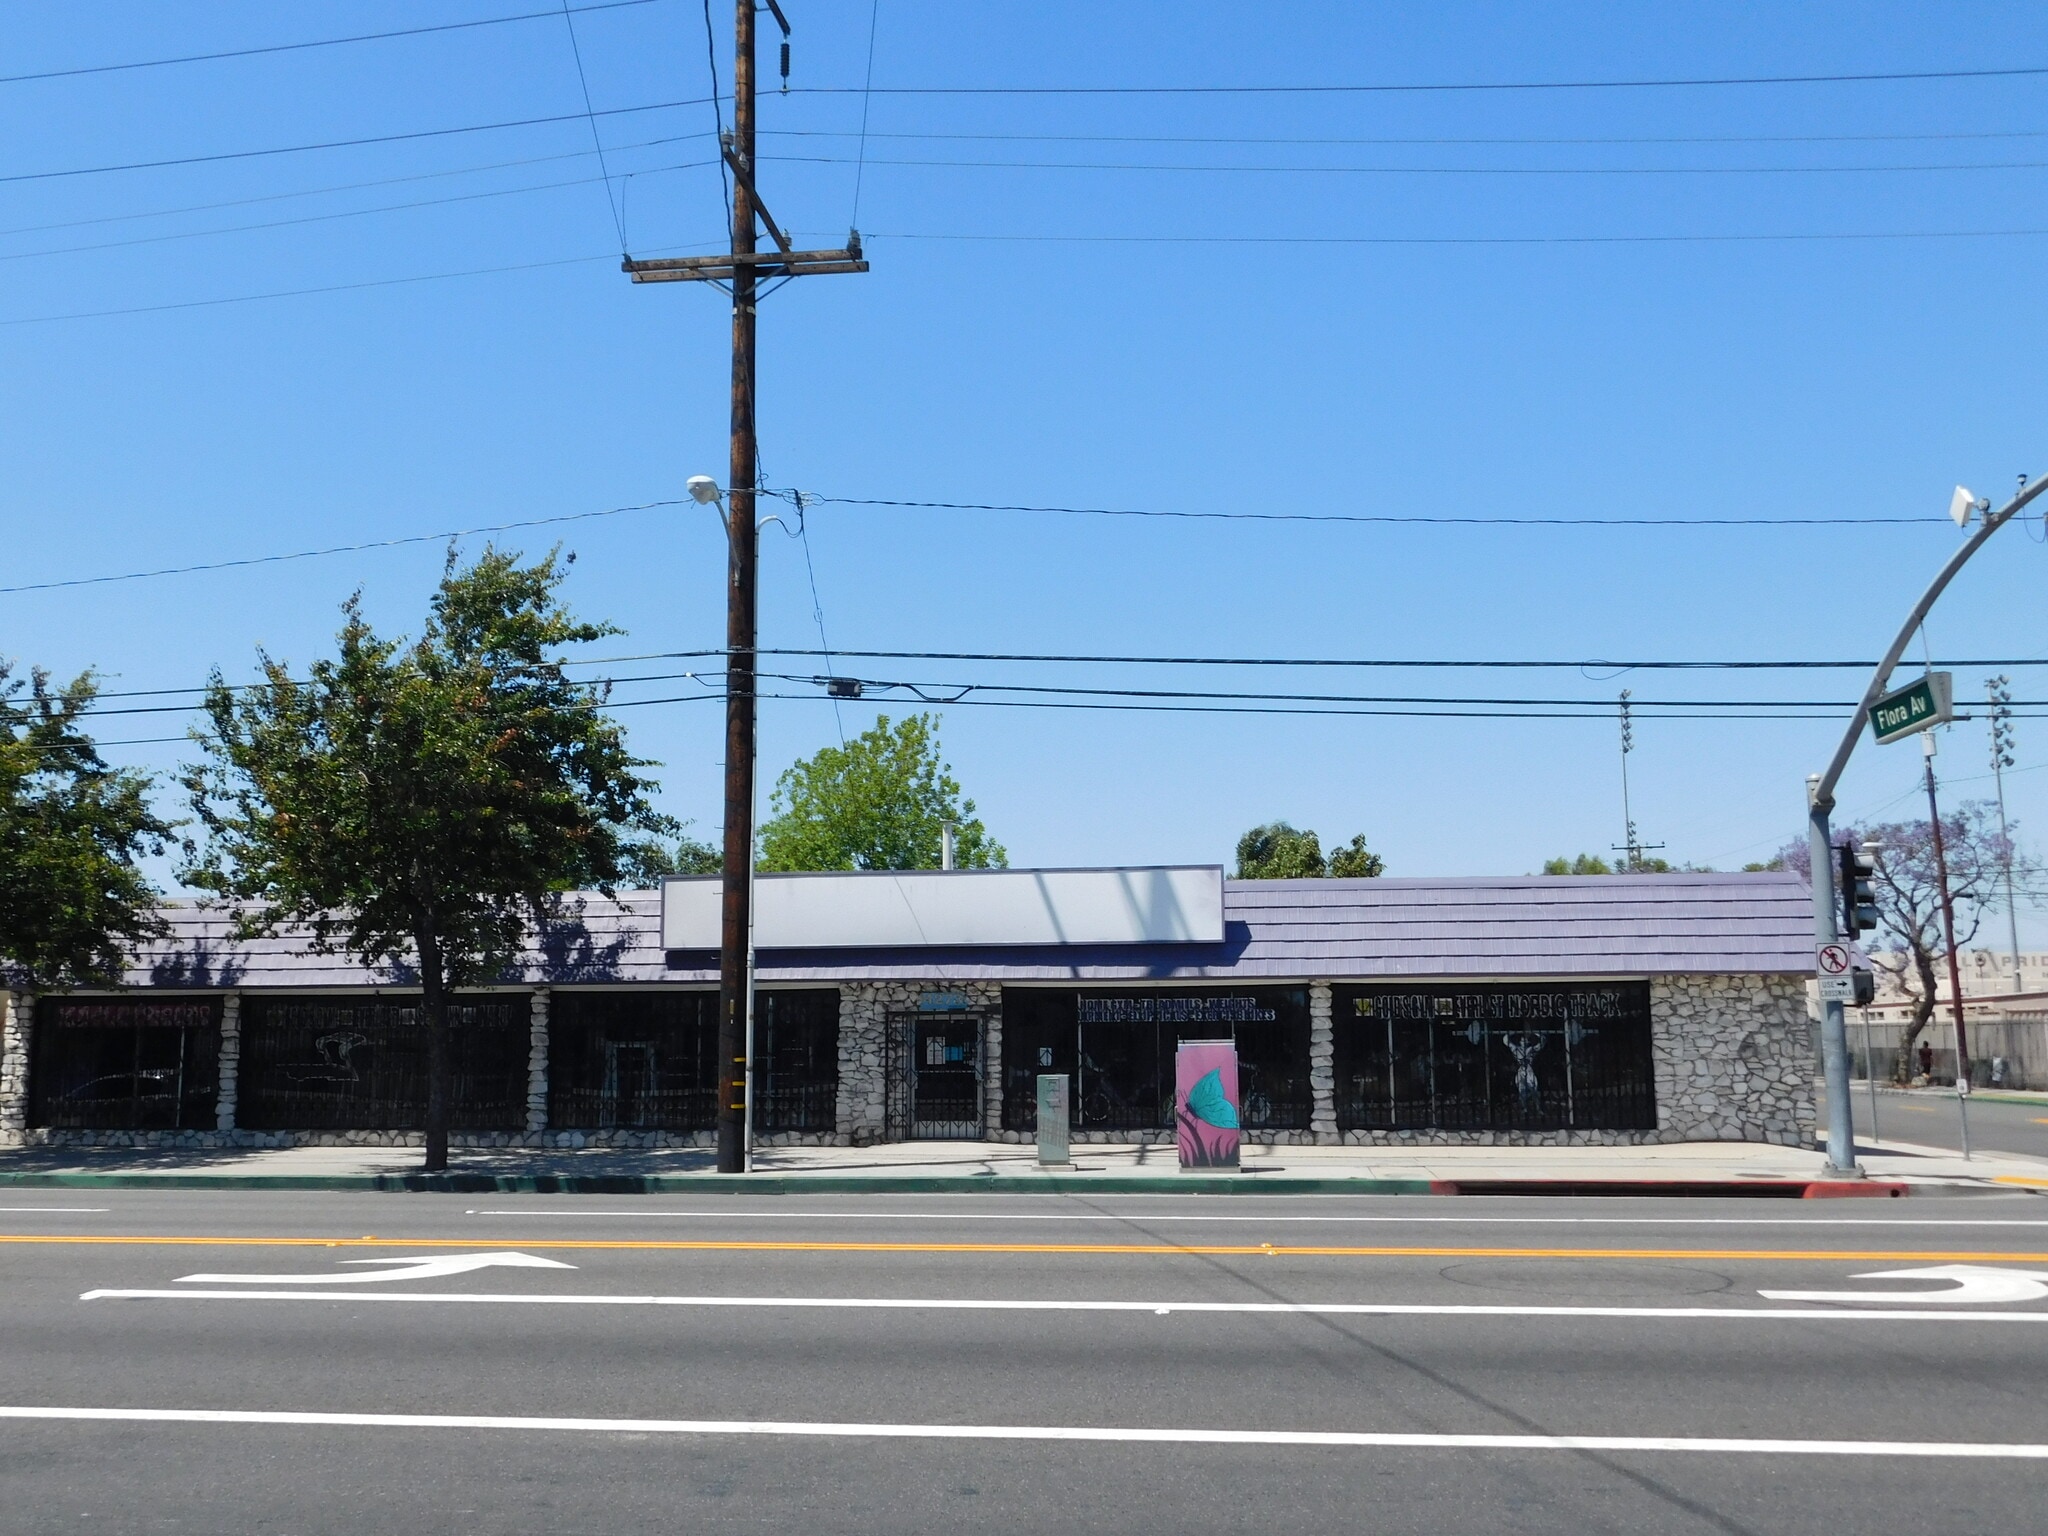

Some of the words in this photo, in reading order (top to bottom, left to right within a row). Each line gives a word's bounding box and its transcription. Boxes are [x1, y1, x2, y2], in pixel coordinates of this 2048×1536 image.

[1877, 705, 1908, 730] Flora
[1910, 696, 1926, 716] Av
[1508, 994, 1566, 1018] NORDIC
[1568, 993, 1621, 1017] TRACK
